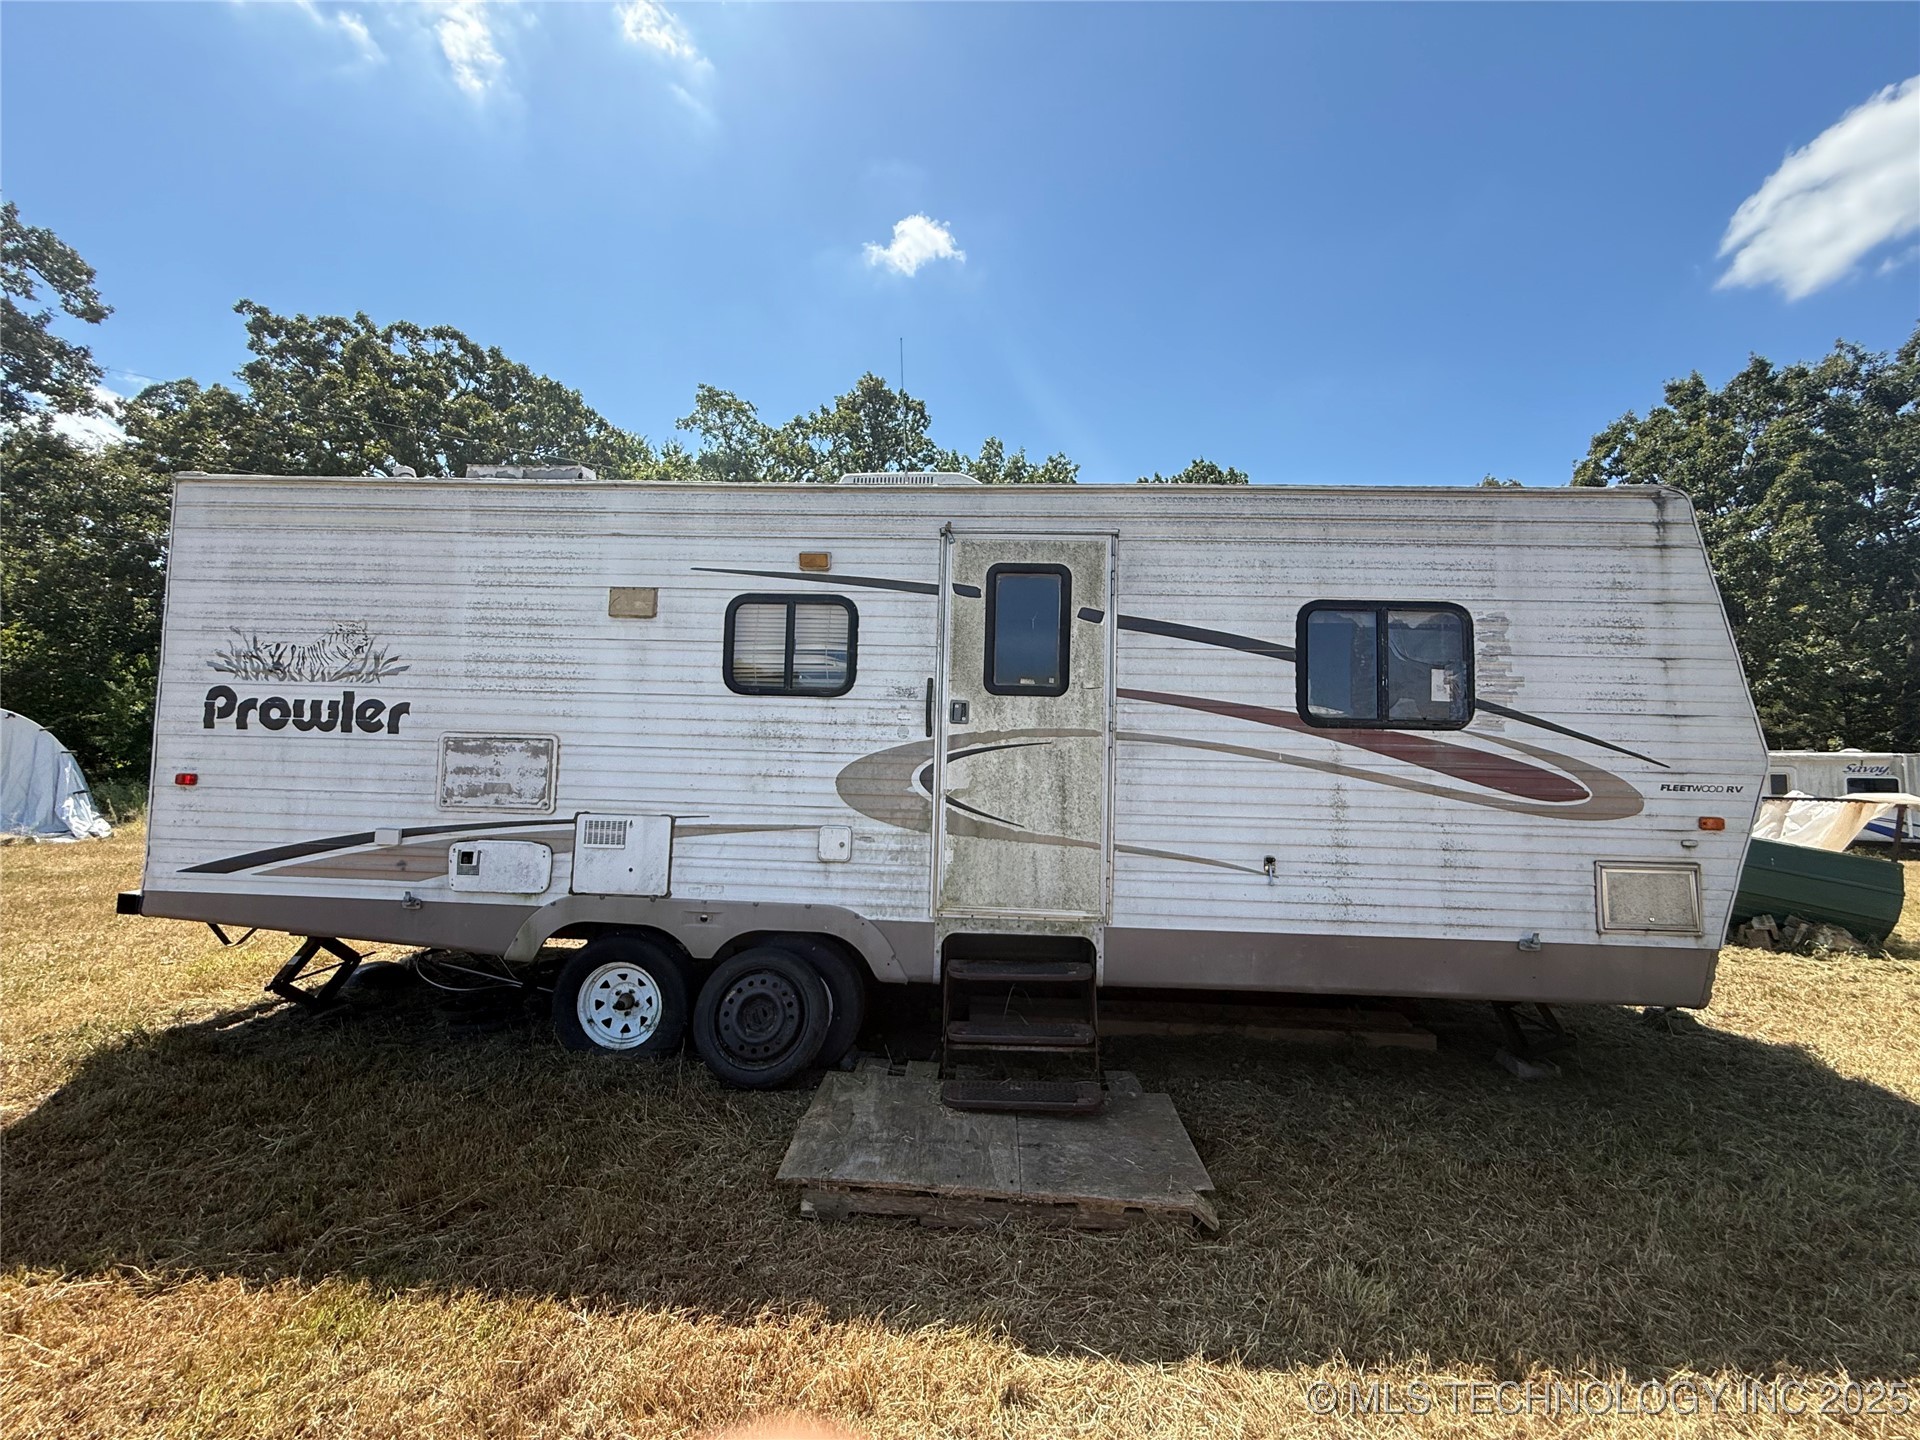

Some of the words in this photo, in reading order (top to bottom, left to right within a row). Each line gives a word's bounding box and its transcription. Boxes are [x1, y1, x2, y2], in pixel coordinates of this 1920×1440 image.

[203, 685, 411, 735] Prowler
[1842, 763, 1890, 776] Savoy
[1660, 783, 1724, 793] FLEETWOOD
[1726, 785, 1744, 793] RV
